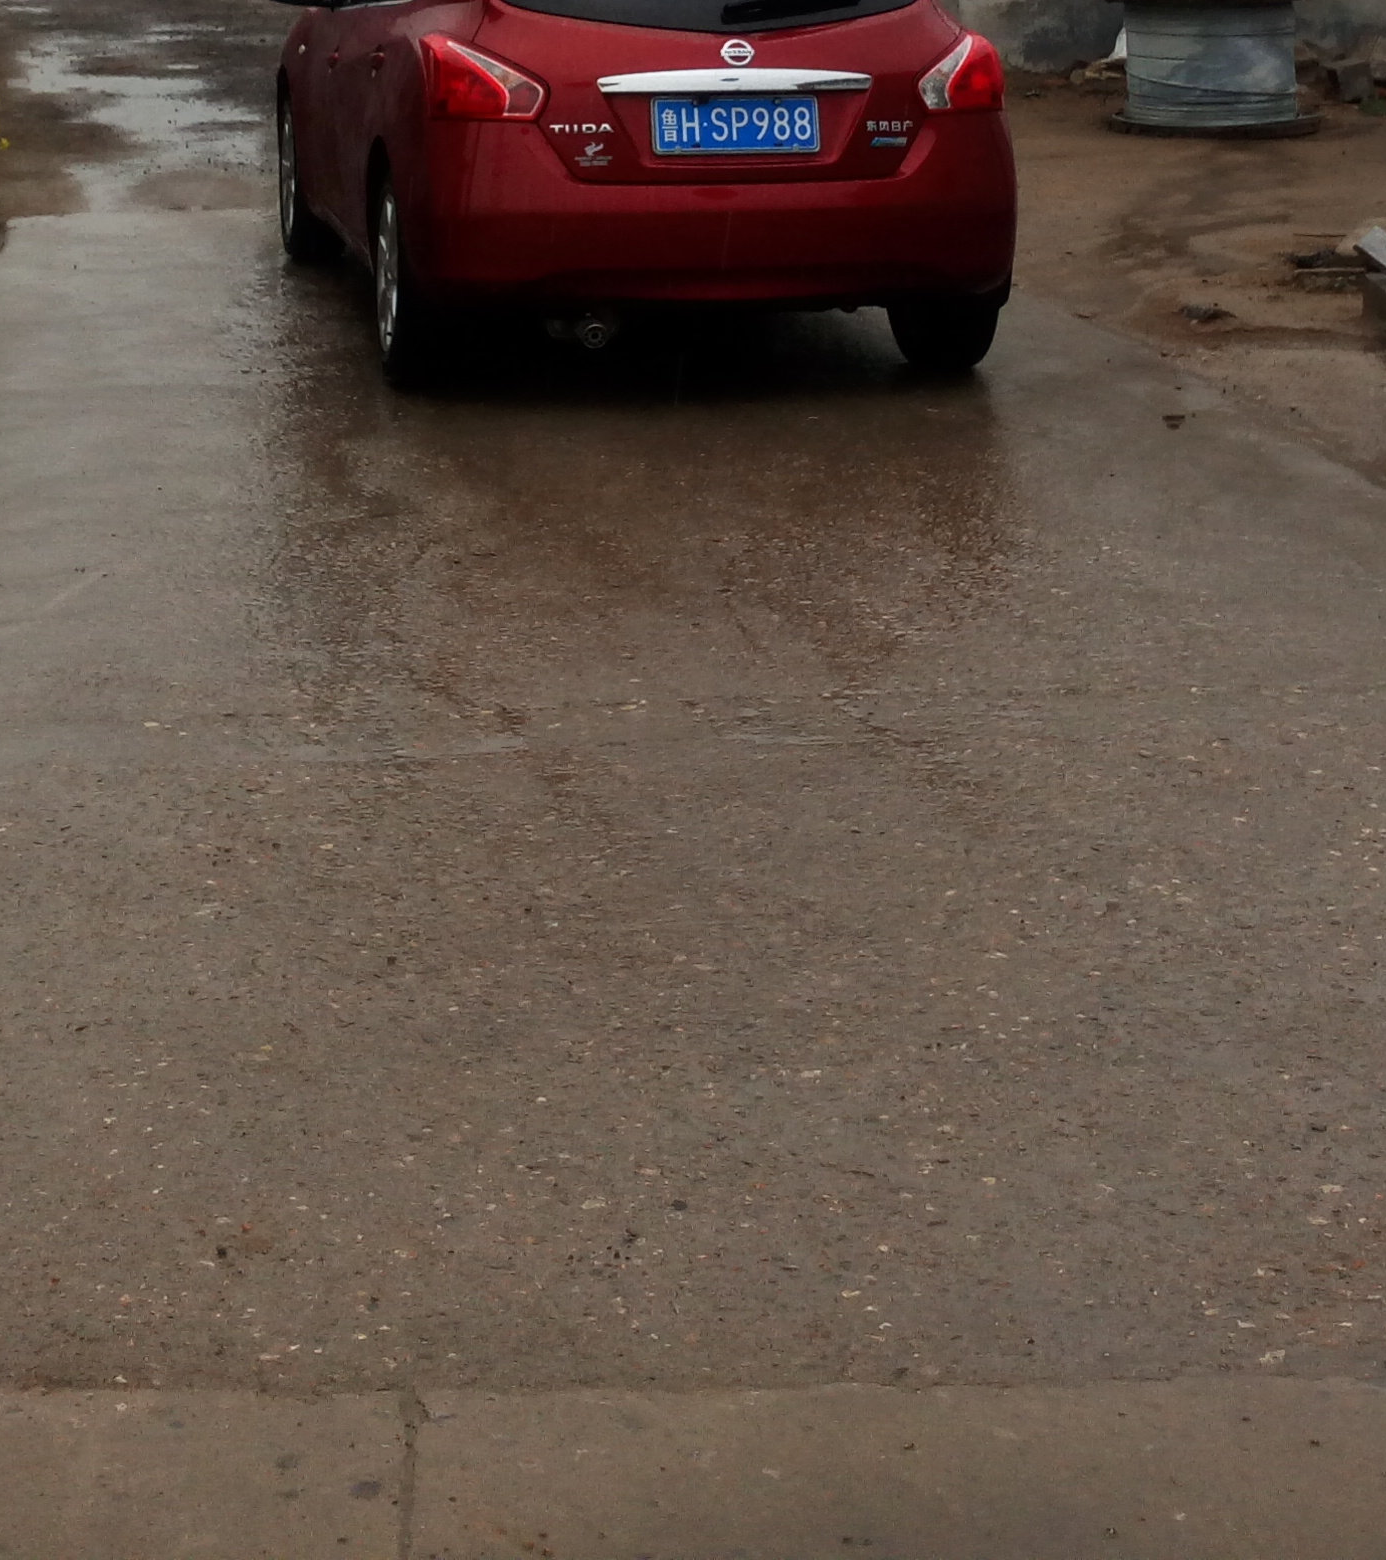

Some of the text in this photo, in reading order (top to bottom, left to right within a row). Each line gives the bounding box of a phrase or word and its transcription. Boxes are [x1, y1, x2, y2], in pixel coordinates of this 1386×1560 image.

[549, 123, 614, 134] TIIDA
[866, 120, 914, 132] 东风日产
